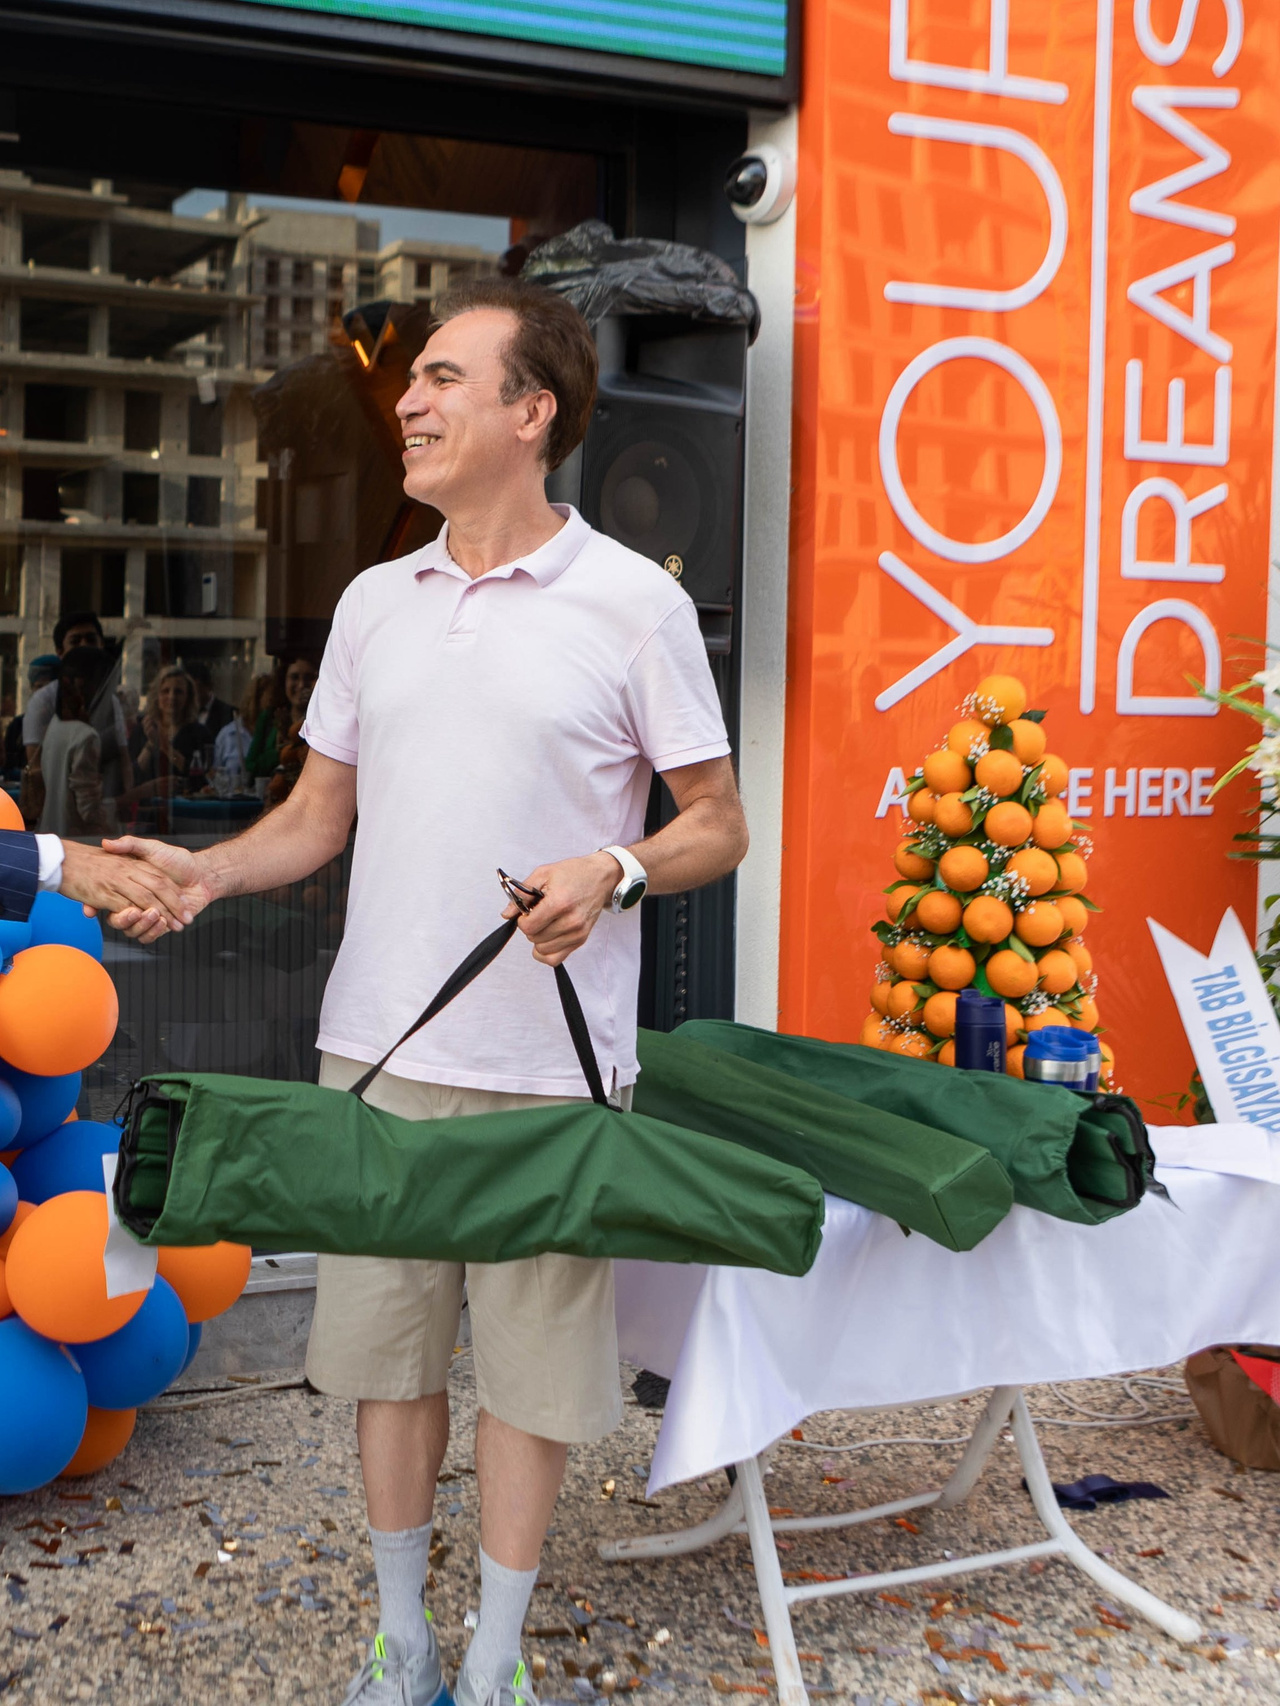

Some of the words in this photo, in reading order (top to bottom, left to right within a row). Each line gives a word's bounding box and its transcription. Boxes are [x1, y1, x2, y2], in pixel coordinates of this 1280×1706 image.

[1116, 0, 1245, 717] DREAMS
[1103, 766, 1216, 817] HERE
[1190, 963, 1246, 1012] TAB
